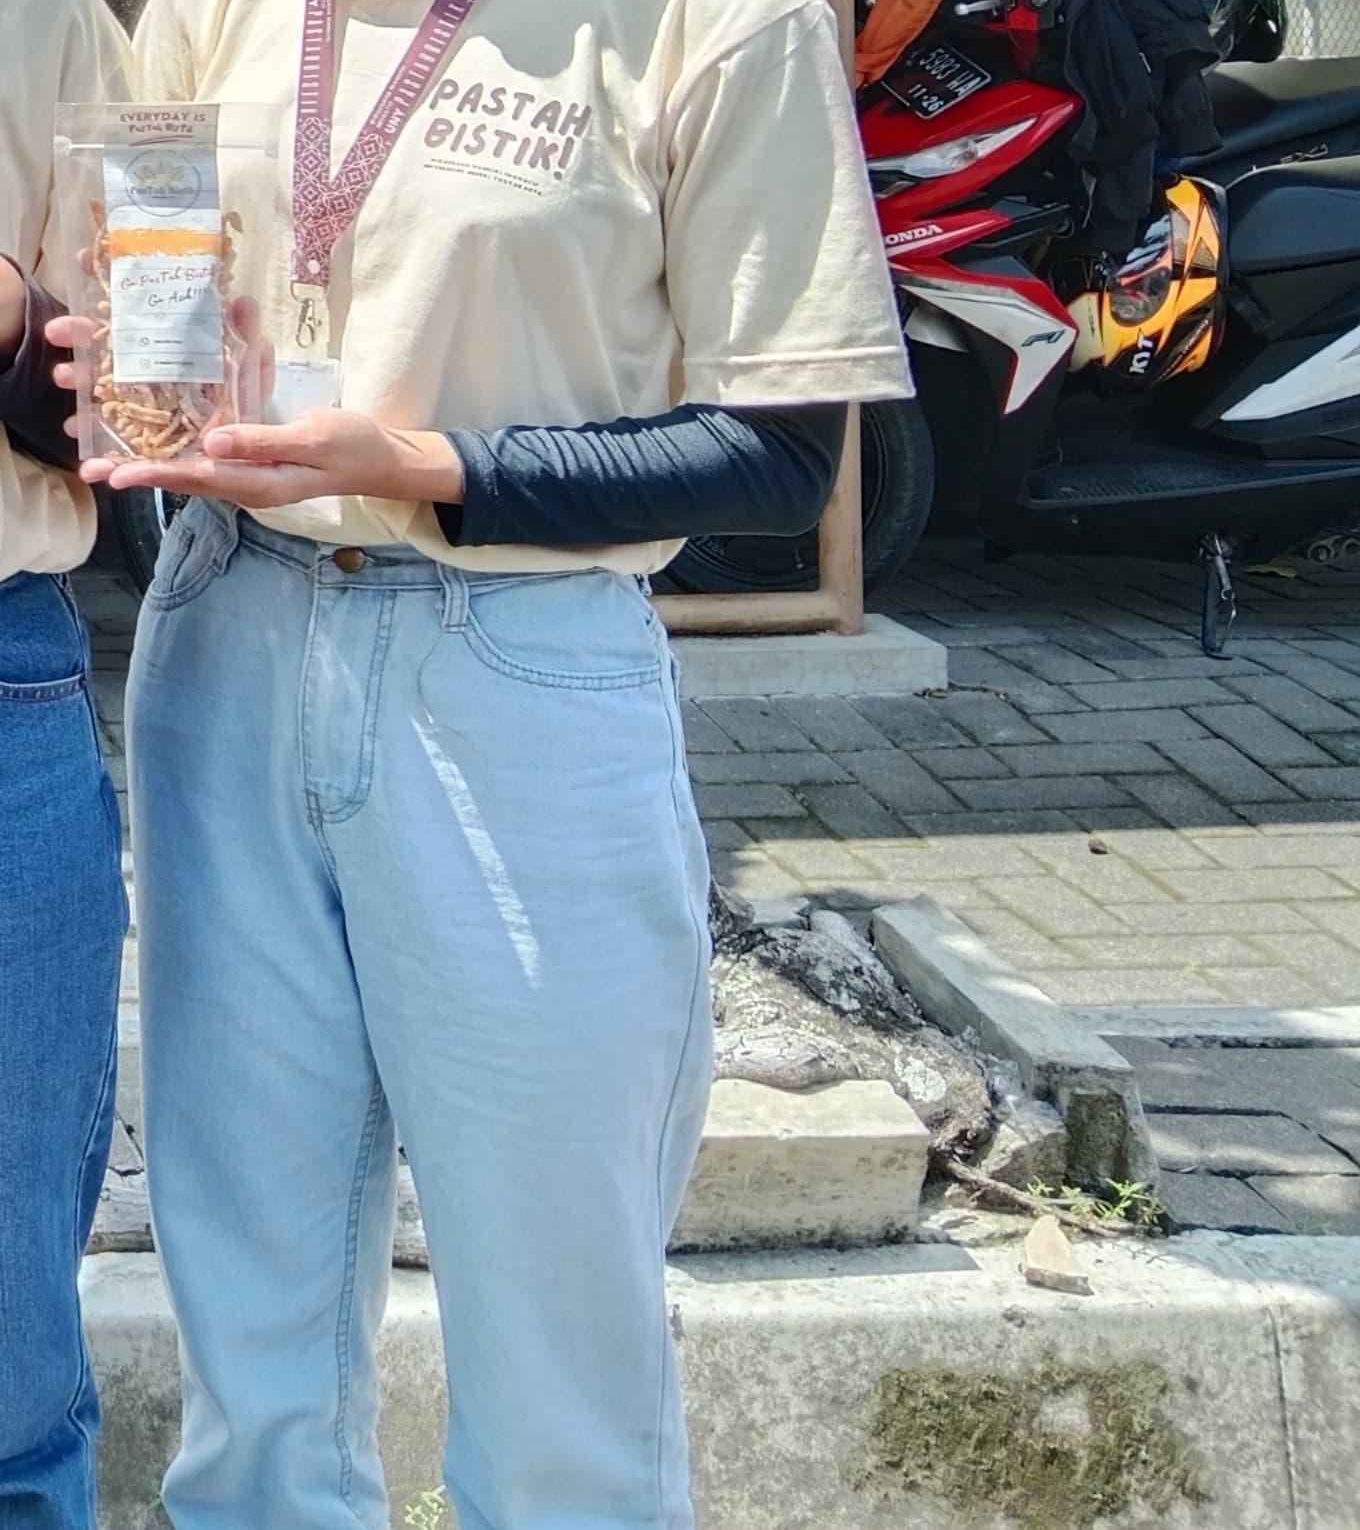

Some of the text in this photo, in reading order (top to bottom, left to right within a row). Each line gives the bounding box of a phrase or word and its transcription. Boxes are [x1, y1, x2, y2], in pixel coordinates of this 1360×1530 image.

[920, 49, 961, 80] 5983
[120, 112, 206, 123] EVERYDAY IS
[384, 108, 405, 133] UNY
[429, 79, 592, 137] PASTAH
[423, 118, 576, 181] BISTIK!
[885, 224, 944, 245] ONDA
